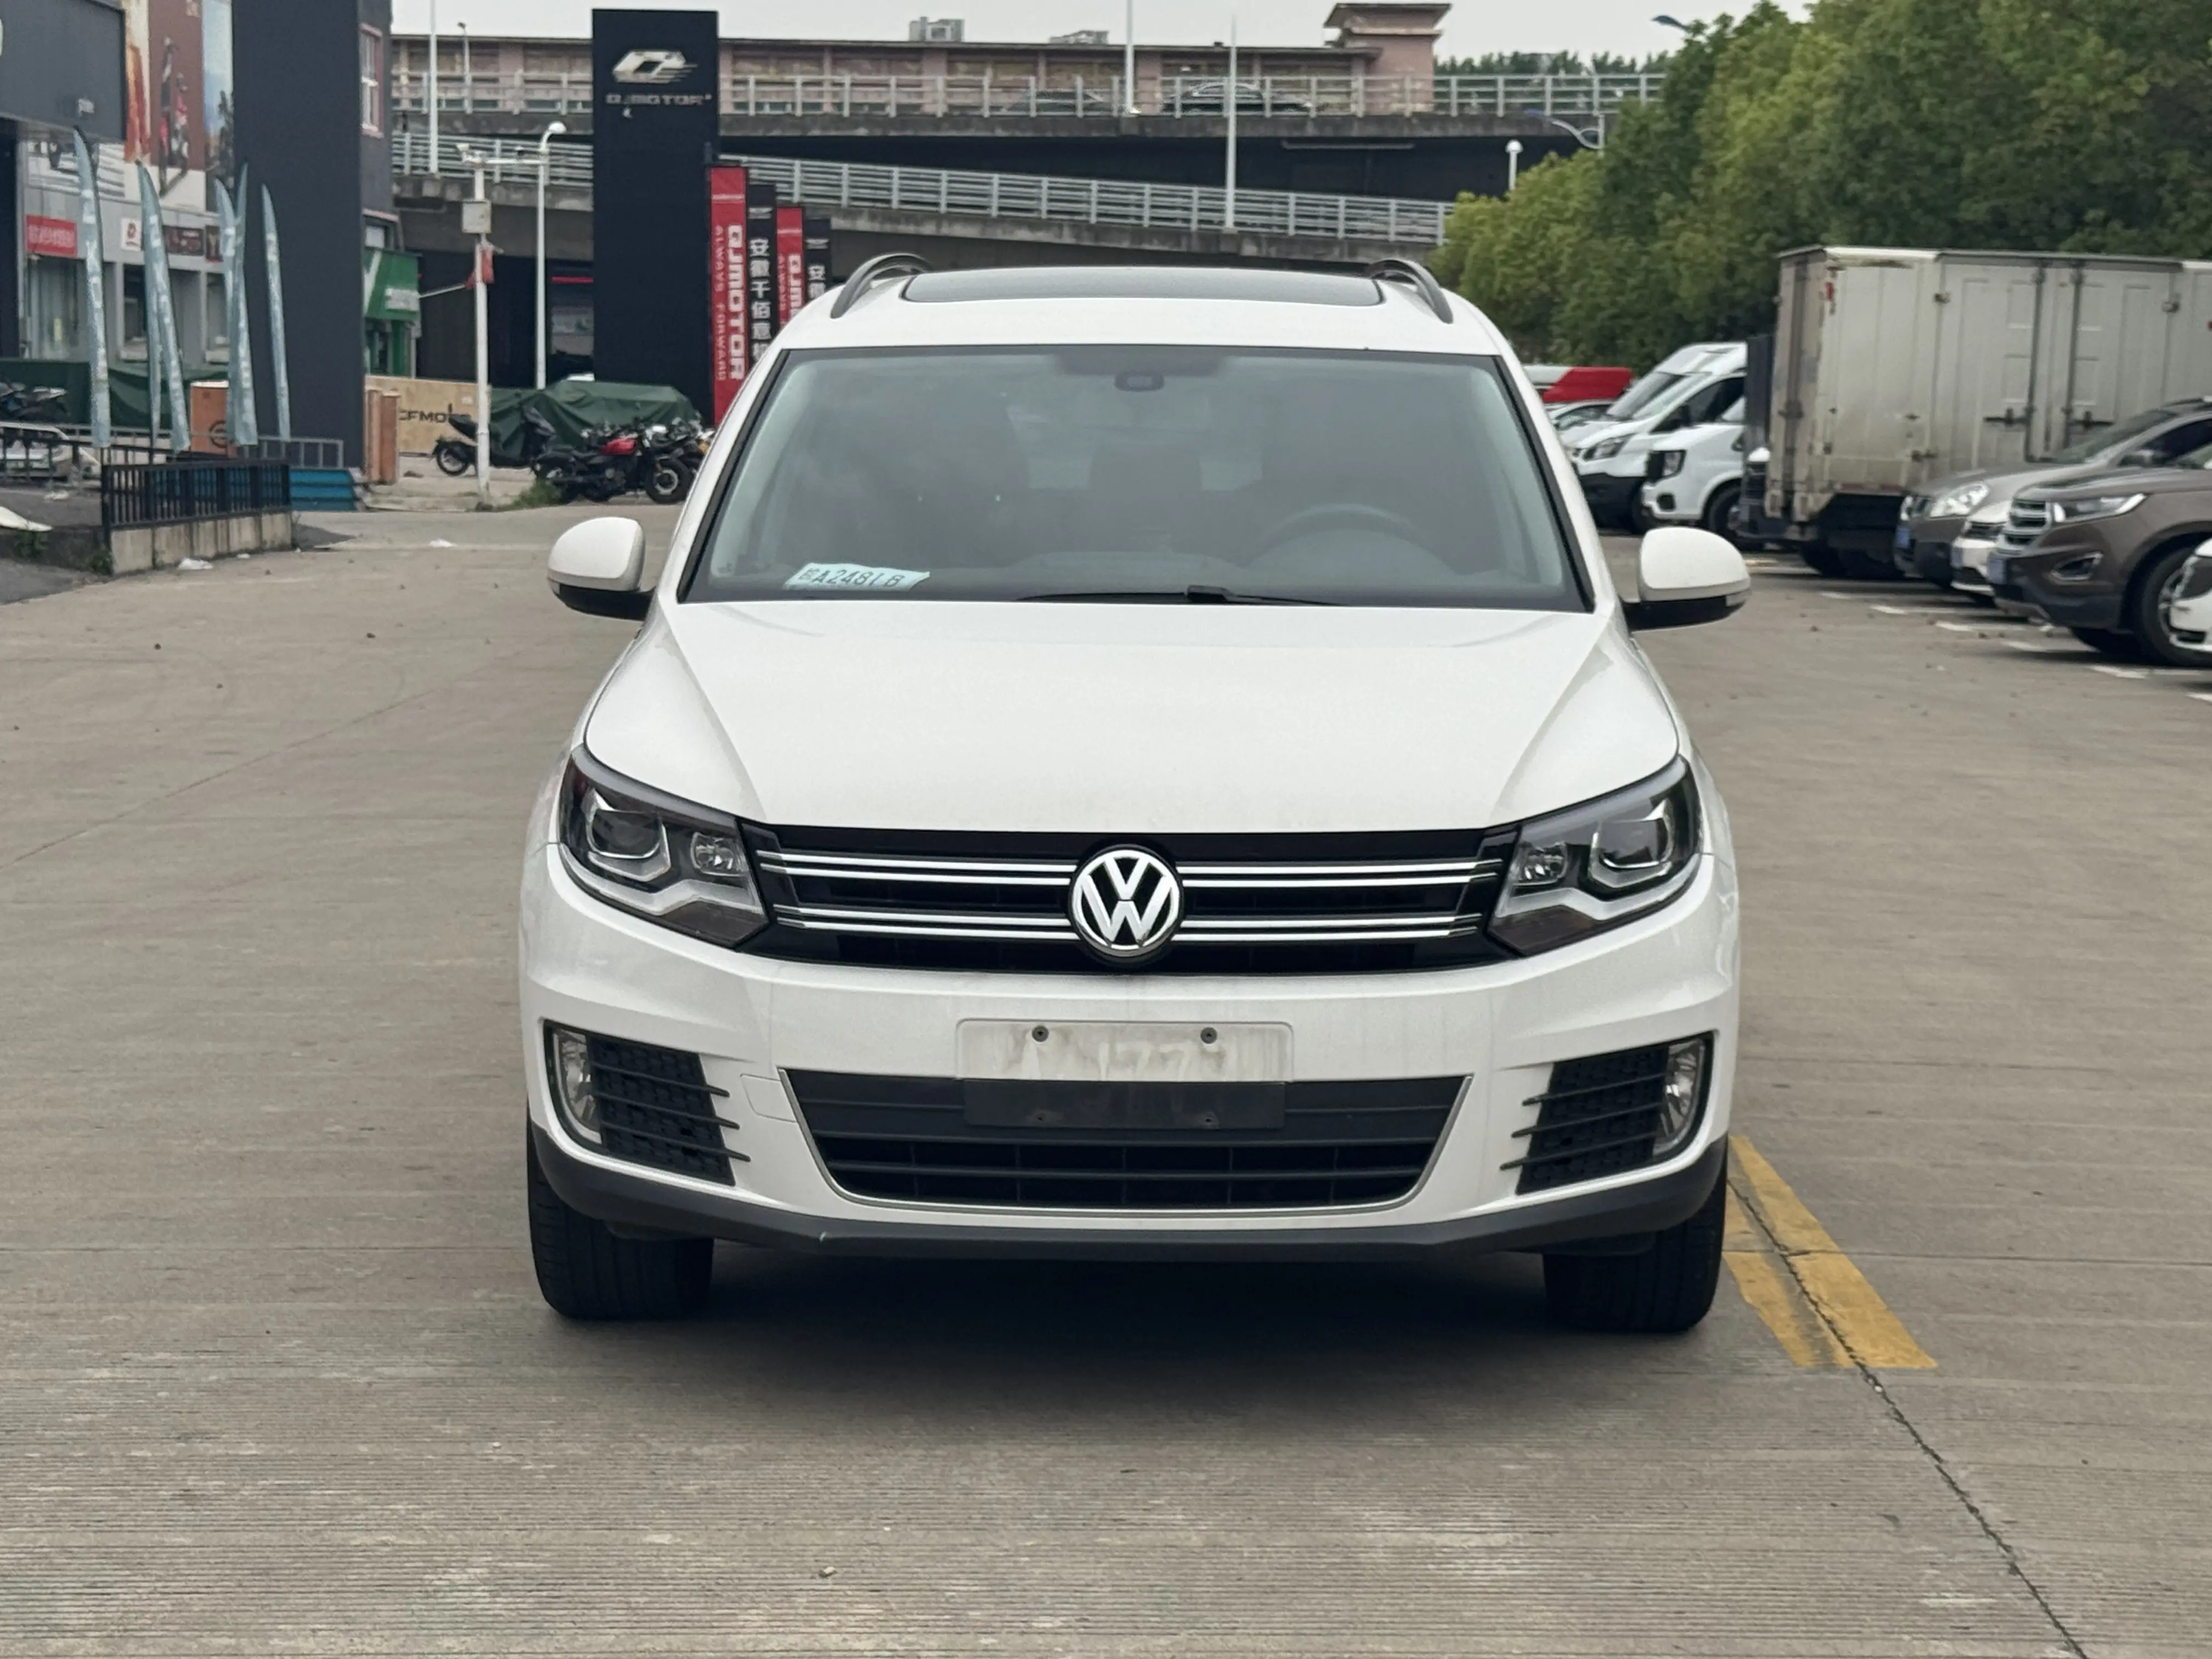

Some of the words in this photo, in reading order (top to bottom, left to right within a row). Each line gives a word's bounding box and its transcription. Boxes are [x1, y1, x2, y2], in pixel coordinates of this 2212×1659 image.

[714, 225, 724, 292] ALWAYS
[727, 224, 745, 380] QJMOTOR
[716, 302, 727, 381] FORWARD
[1075, 852, 1176, 949] VW
